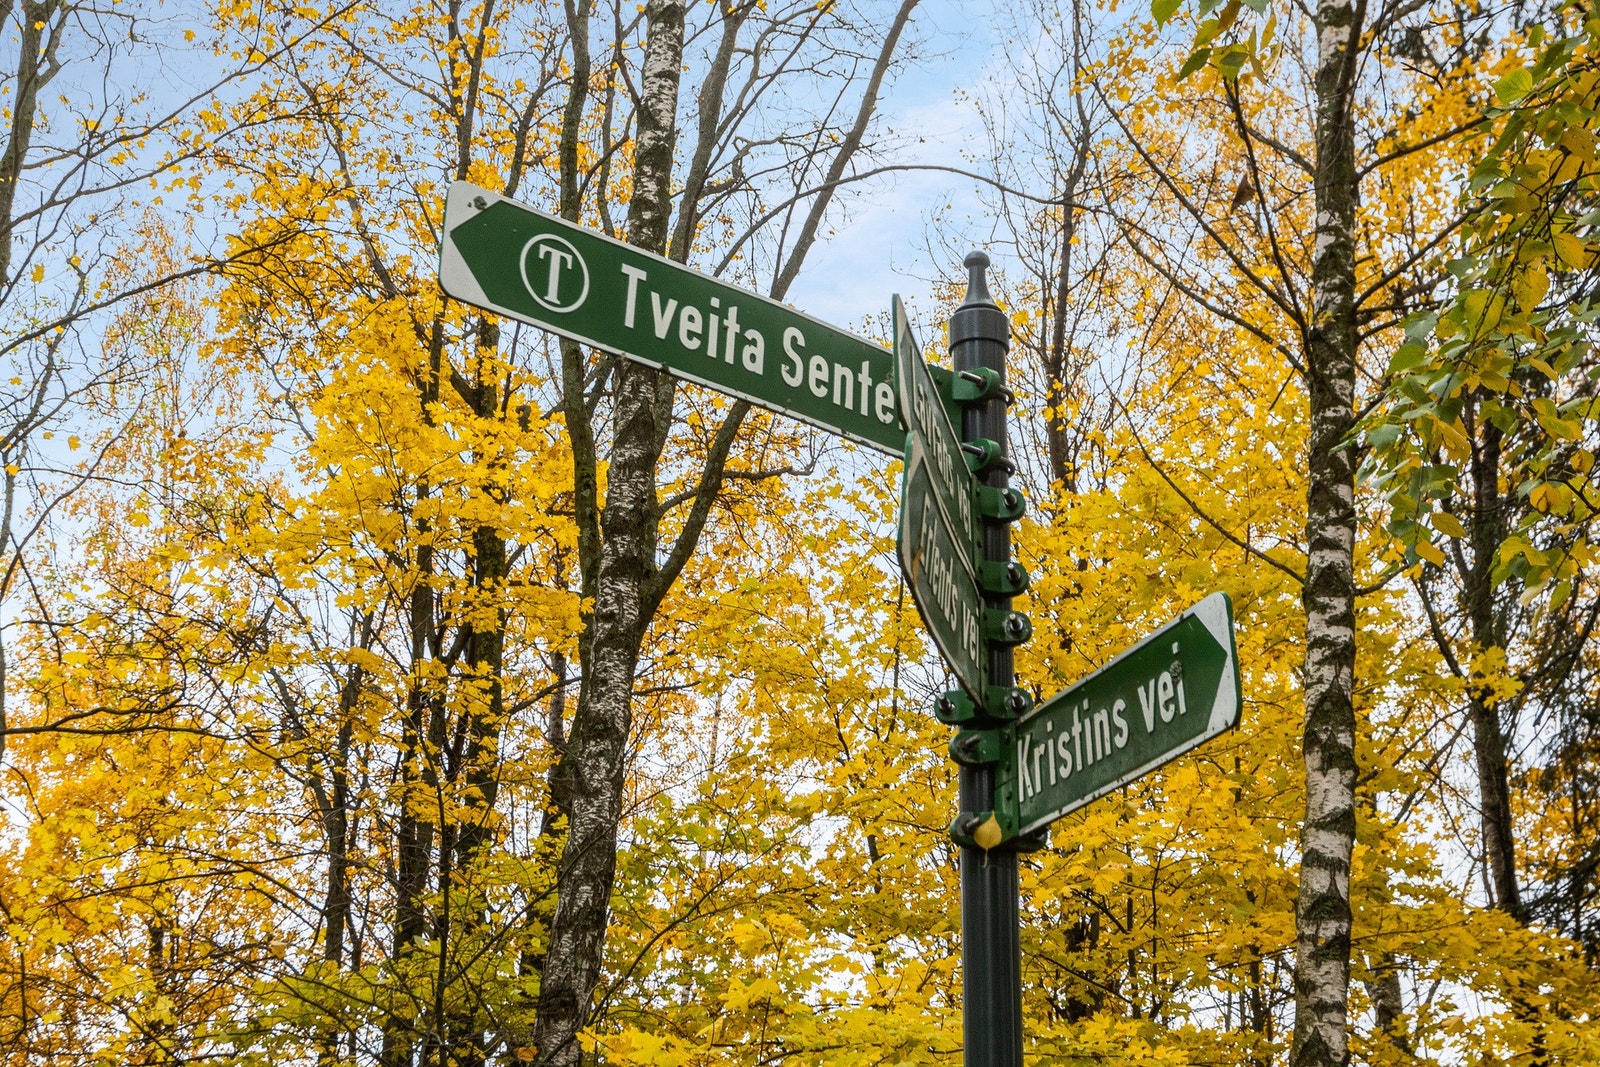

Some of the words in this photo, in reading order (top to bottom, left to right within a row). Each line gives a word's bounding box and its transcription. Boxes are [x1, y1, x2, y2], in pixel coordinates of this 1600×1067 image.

[538, 243, 573, 305] T
[621, 263, 765, 376] Tveita
[781, 326, 904, 431] Sente
[911, 346, 954, 499] Lavrans
[956, 474, 972, 541] vei
[920, 492, 958, 632] Erlends
[962, 600, 980, 669] vei
[1017, 698, 1129, 803] Kristins
[1137, 641, 1187, 733] vei
